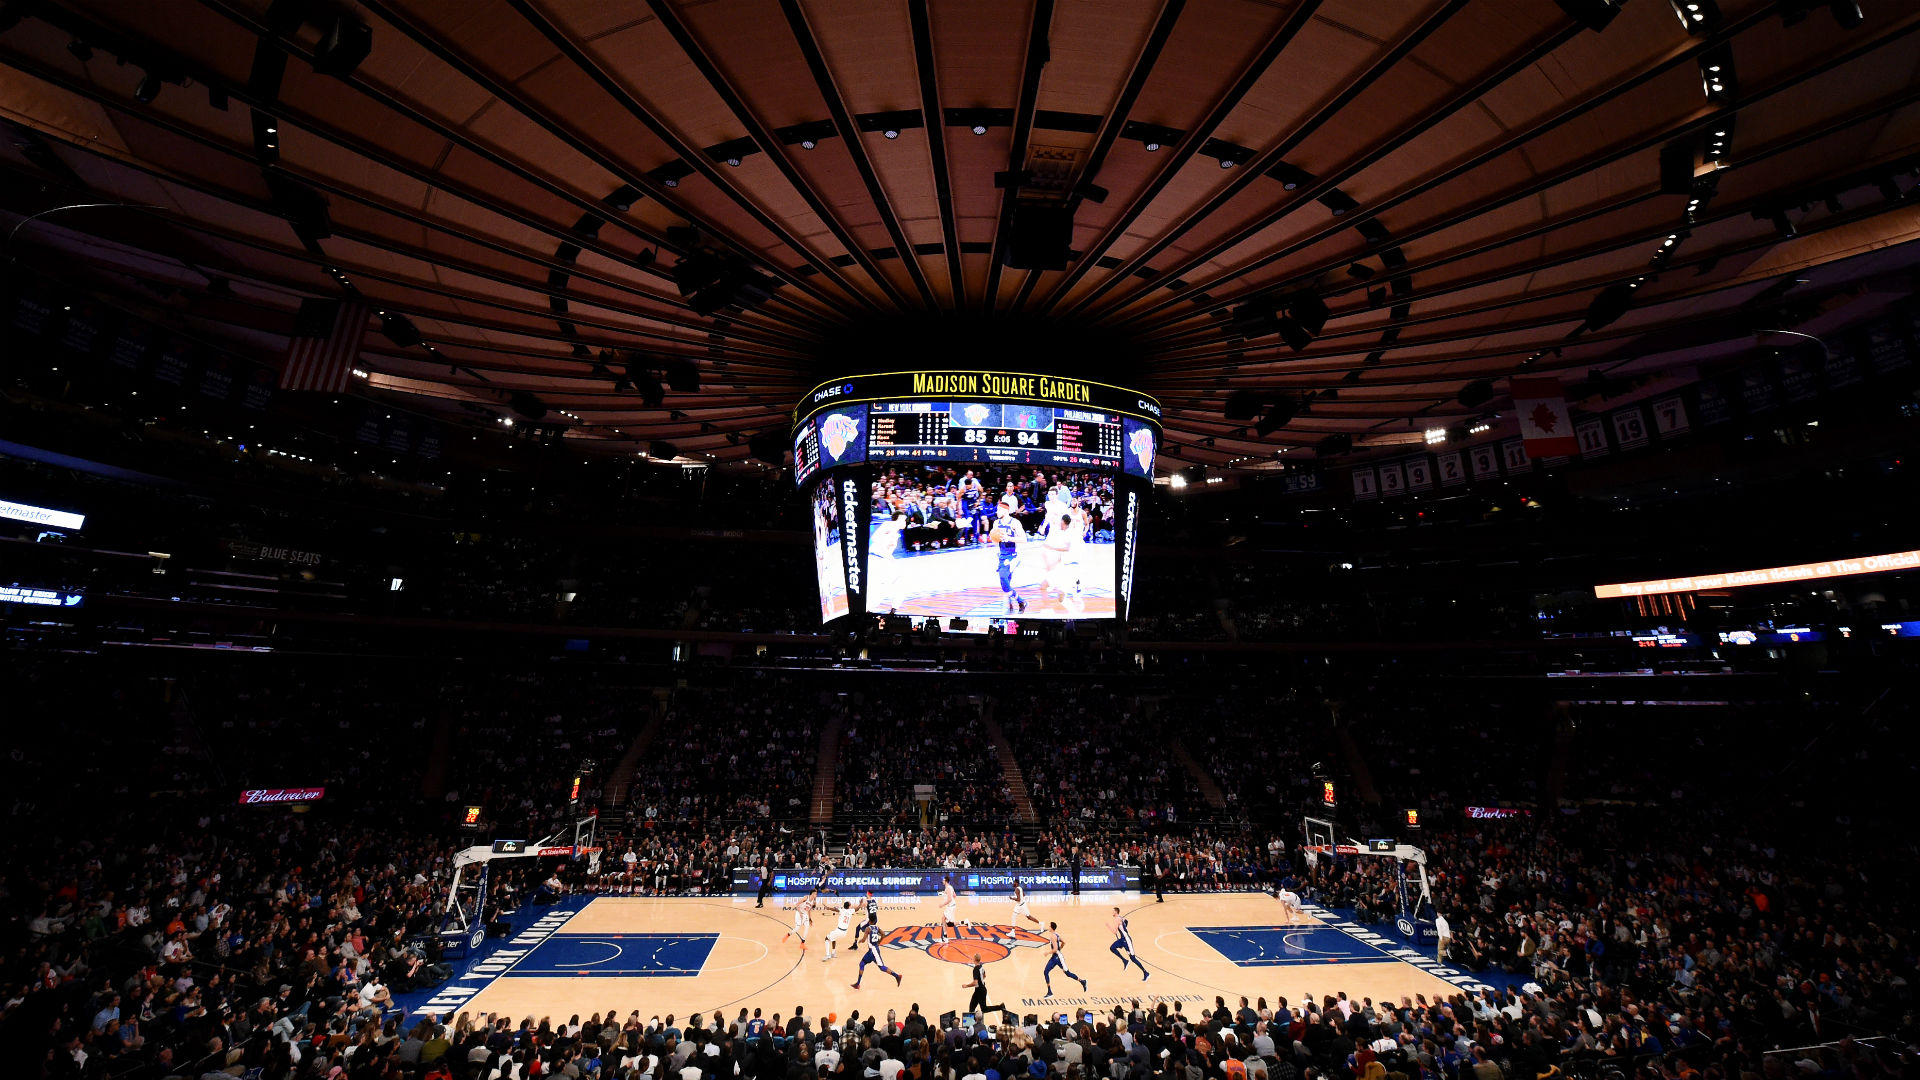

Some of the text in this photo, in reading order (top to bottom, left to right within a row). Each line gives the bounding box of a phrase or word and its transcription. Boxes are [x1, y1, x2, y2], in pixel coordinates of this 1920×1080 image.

[814, 385, 842, 403] CHASE
[913, 373, 1090, 403] MADISON SQUARE GARDEN
[1138, 399, 1161, 417] CHASE
[964, 429, 987, 443] 85
[993, 435, 1011, 443] 5:05
[1017, 431, 1039, 446] 94
[1619, 419, 1642, 441] 19
[1583, 430, 1602, 451] 11
[1508, 447, 1526, 467] 11
[1446, 462, 1458, 479] 2
[843, 479, 861, 595] ticketmaster
[260, 546, 322, 565] BLUE SEATS
[1620, 551, 1920, 596] Buy and sell your Knicks tickets at The Official
[245, 789, 320, 804] Budweiser
[466, 814, 477, 822] 22
[827, 877, 844, 886] FOR
[845, 877, 881, 886] SPECIAL
[882, 877, 922, 886] SURGERY
[1019, 877, 1035, 885] FOR
[1036, 877, 1070, 885] SPECIAL
[1071, 876, 1110, 884] URGERY
[868, 906, 877, 914] 25
[879, 924, 1052, 946] KNICKS
[412, 911, 576, 1015] NEW YORK KNICKS
[1332, 922, 1398, 946] YORK
[1387, 949, 1496, 992] KNICKS
[1021, 993, 1205, 1007] MADISON SQUARE GARDEN
